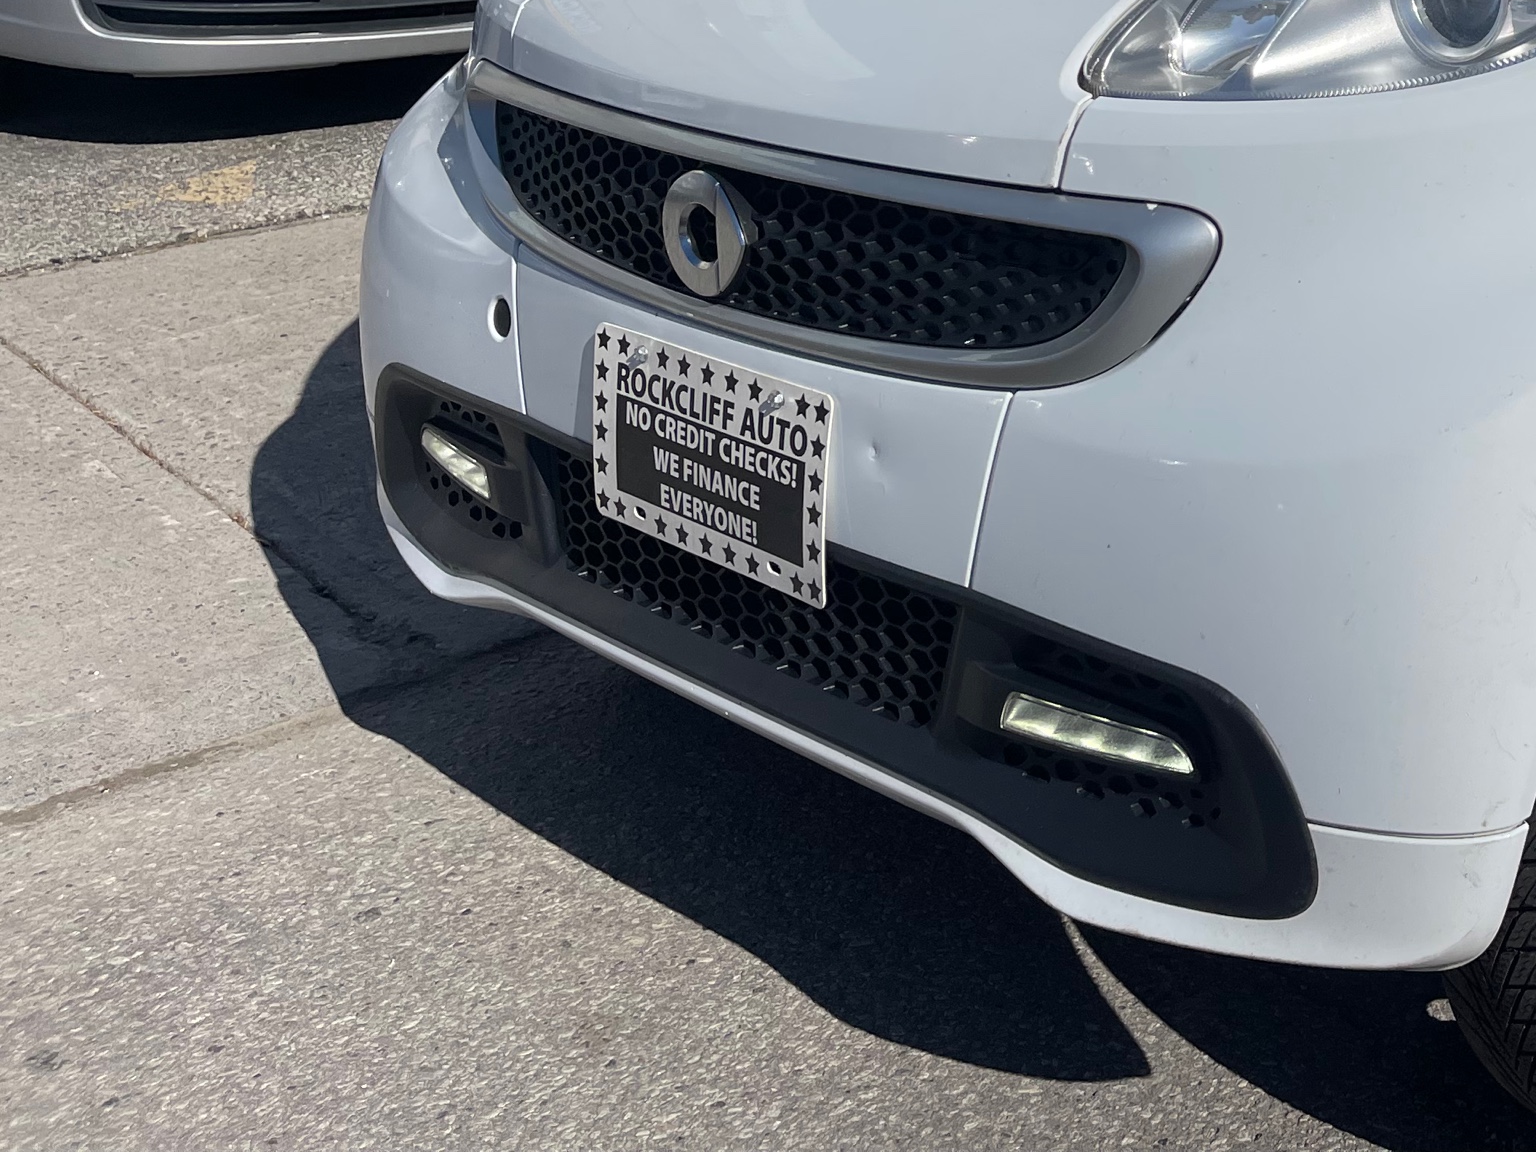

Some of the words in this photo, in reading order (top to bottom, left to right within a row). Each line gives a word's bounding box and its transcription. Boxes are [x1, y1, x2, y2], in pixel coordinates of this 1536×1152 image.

[616, 362, 735, 430] ROCKCLIFF
[740, 408, 808, 457] AUTO
[626, 401, 650, 431] NO
[655, 411, 715, 457] CREDIT
[719, 437, 797, 488] CHECKS!
[653, 446, 679, 478] WE
[683, 459, 760, 510] FINANCE
[660, 484, 758, 545] EVERYONE!
